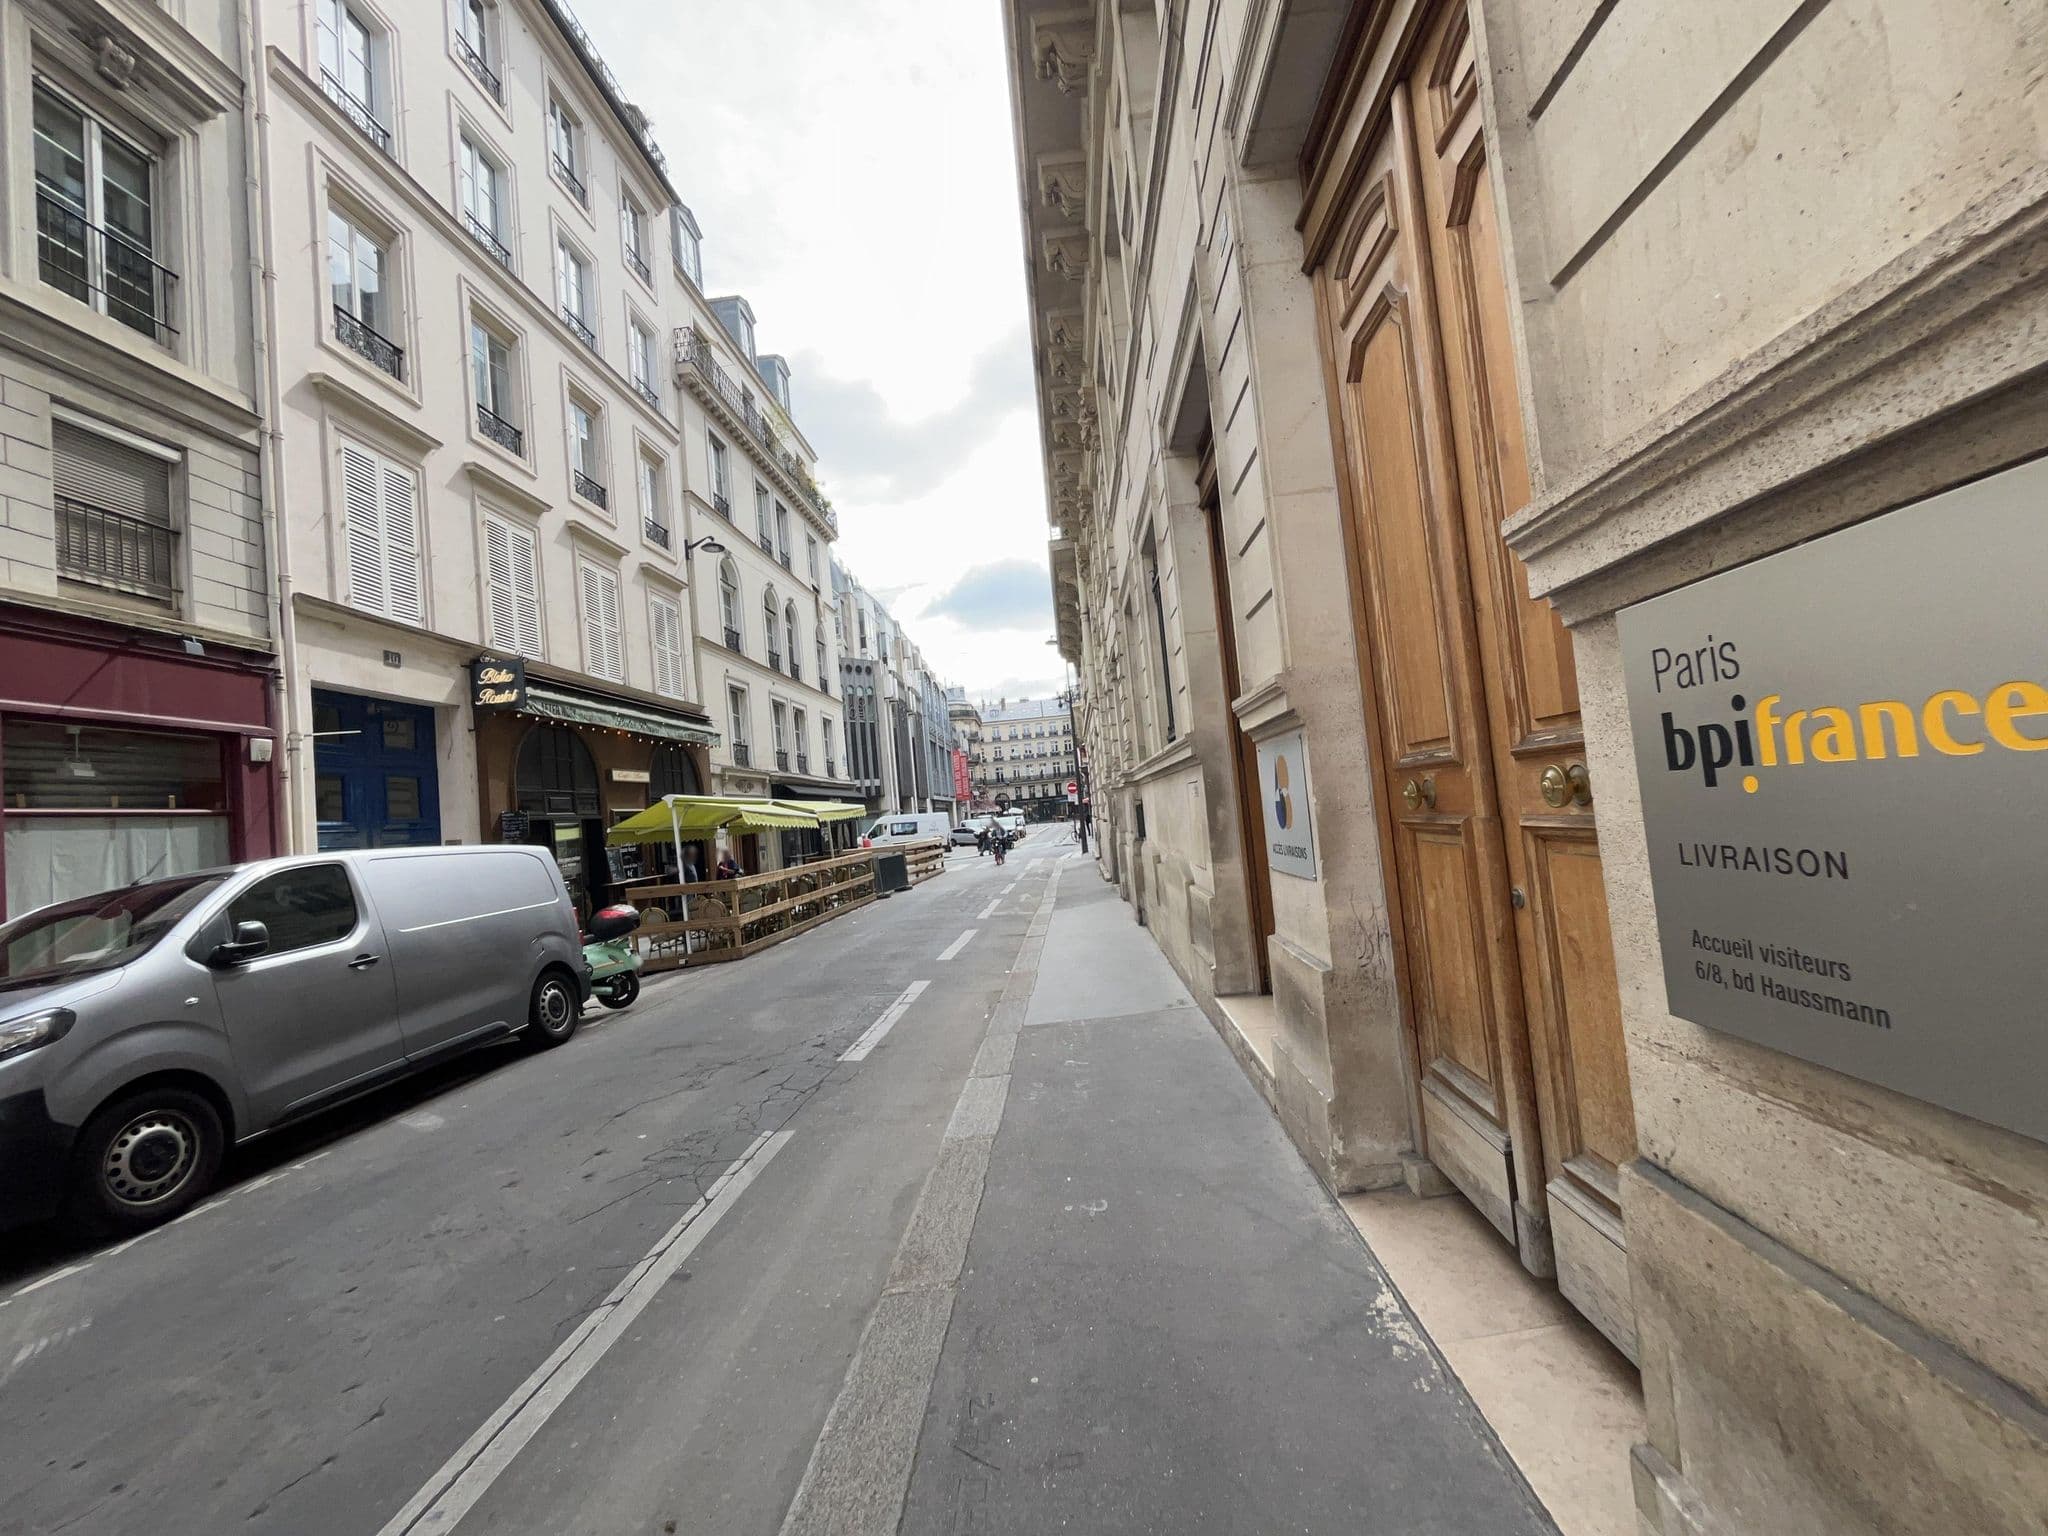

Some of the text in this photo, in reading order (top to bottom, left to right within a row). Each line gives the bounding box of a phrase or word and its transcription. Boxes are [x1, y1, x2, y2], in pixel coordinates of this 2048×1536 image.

[1652, 634, 1741, 693] Paris
[1660, 680, 2048, 793] bpifrance
[1678, 843, 1849, 880] LIVRAISON
[1692, 929, 1851, 982] Accueil visiteurs
[1695, 960, 1892, 1030] 6/8, bd Haussmann
